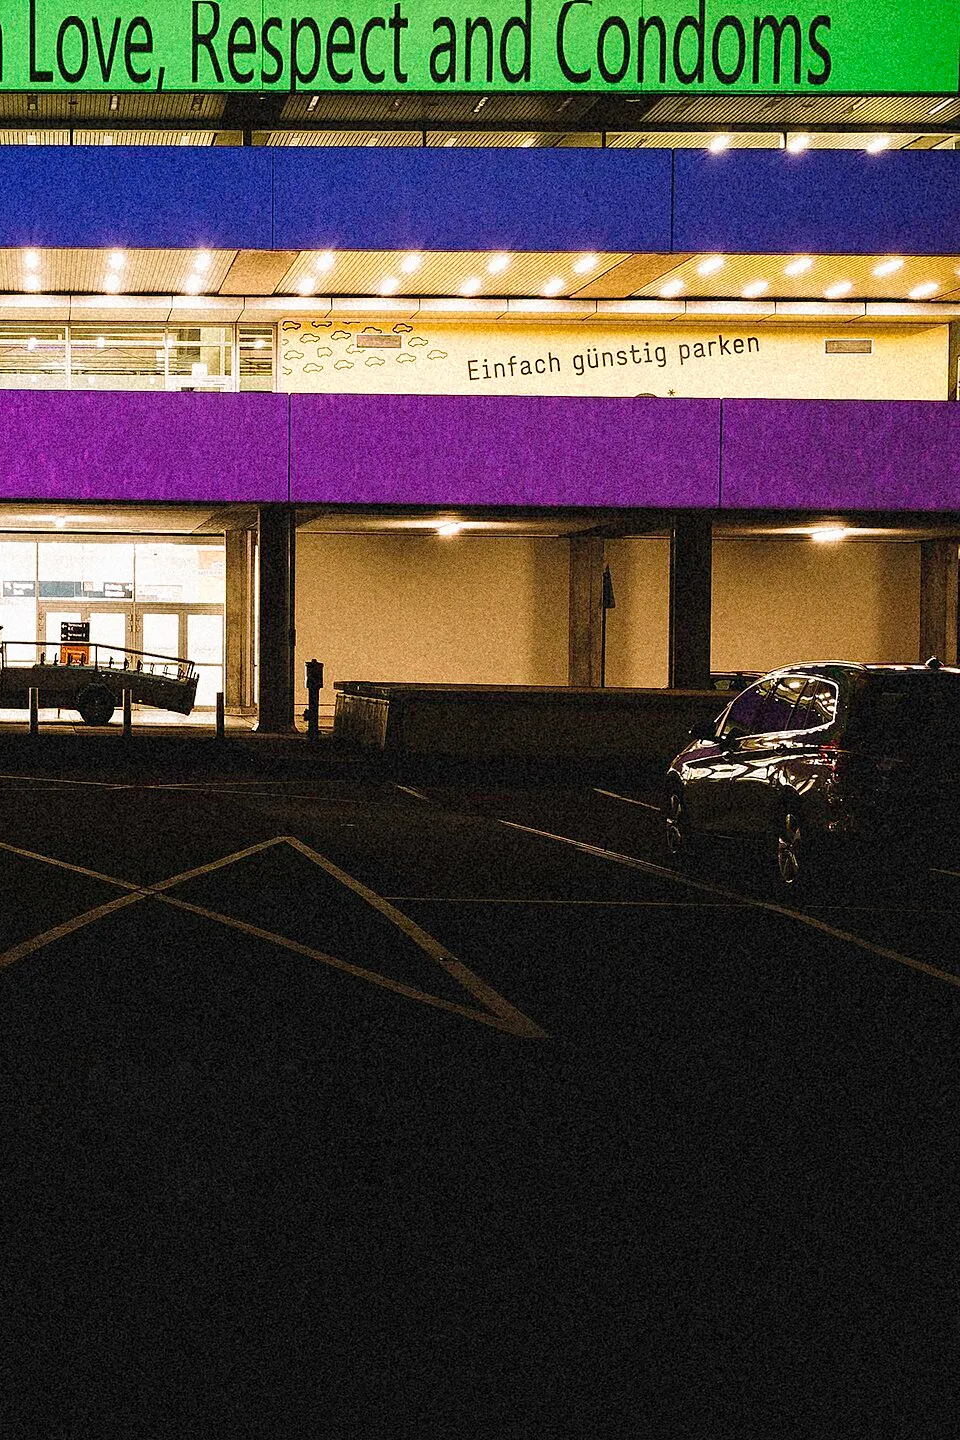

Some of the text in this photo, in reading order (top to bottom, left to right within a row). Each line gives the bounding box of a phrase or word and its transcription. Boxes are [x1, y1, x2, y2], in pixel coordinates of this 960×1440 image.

[191, 0, 409, 92] Respect
[467, 335, 760, 381] Einfach günstig parken
